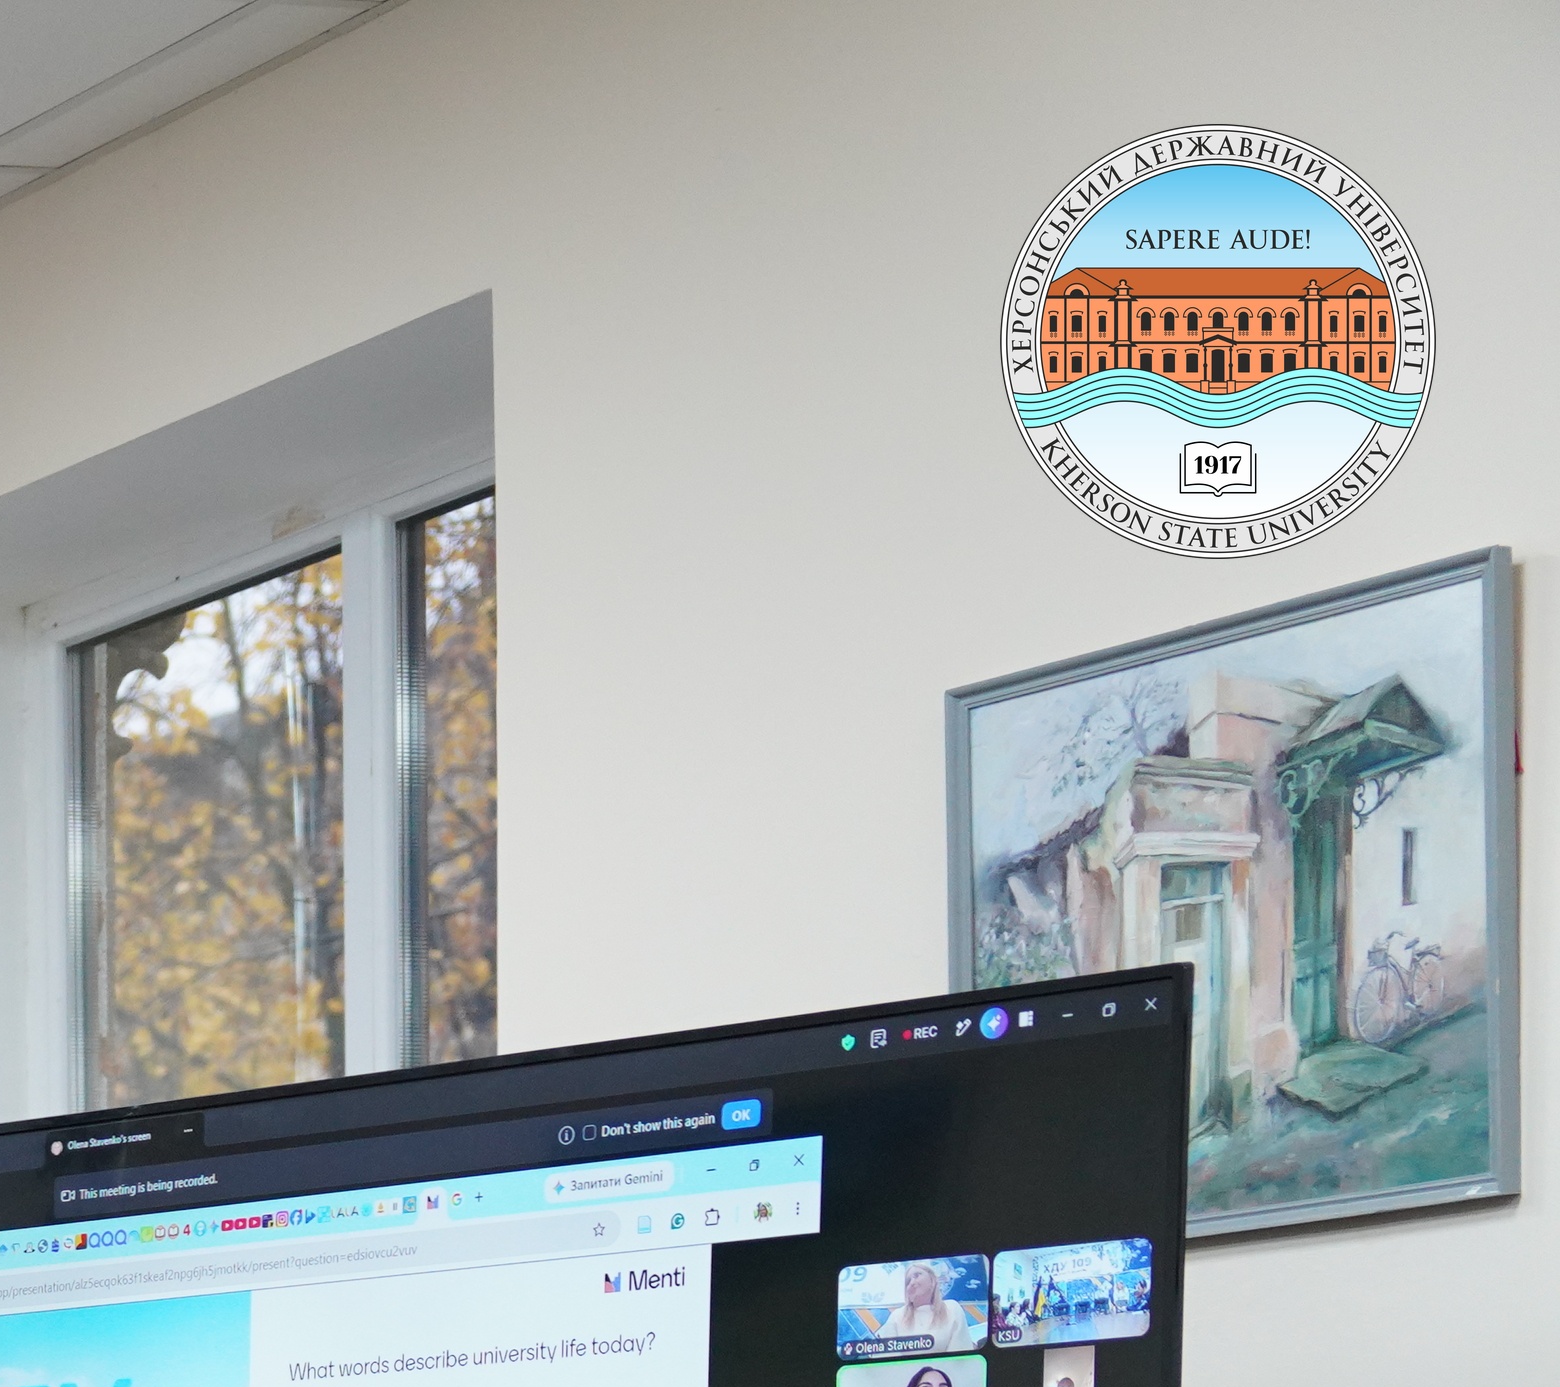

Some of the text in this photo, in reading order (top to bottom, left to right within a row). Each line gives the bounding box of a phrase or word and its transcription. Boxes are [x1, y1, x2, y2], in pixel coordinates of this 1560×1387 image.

[913, 1025, 938, 1040] REC
[601, 1112, 715, 1138] Don't show this again
[731, 1107, 752, 1123] OK
[67, 1138, 89, 1152] Olena
[126, 1131, 152, 1145] screen
[79, 1173, 218, 1201] This meeting is being recorded.
[569, 1169, 664, 1193] Запитати Gemini
[1071, 1256, 1092, 1271] 109
[628, 1266, 686, 1292] Menti
[855, 1337, 932, 1354] Olena Stavenko
[997, 1329, 1021, 1342] KSU
[288, 1331, 656, 1382] What words describe university life today?
